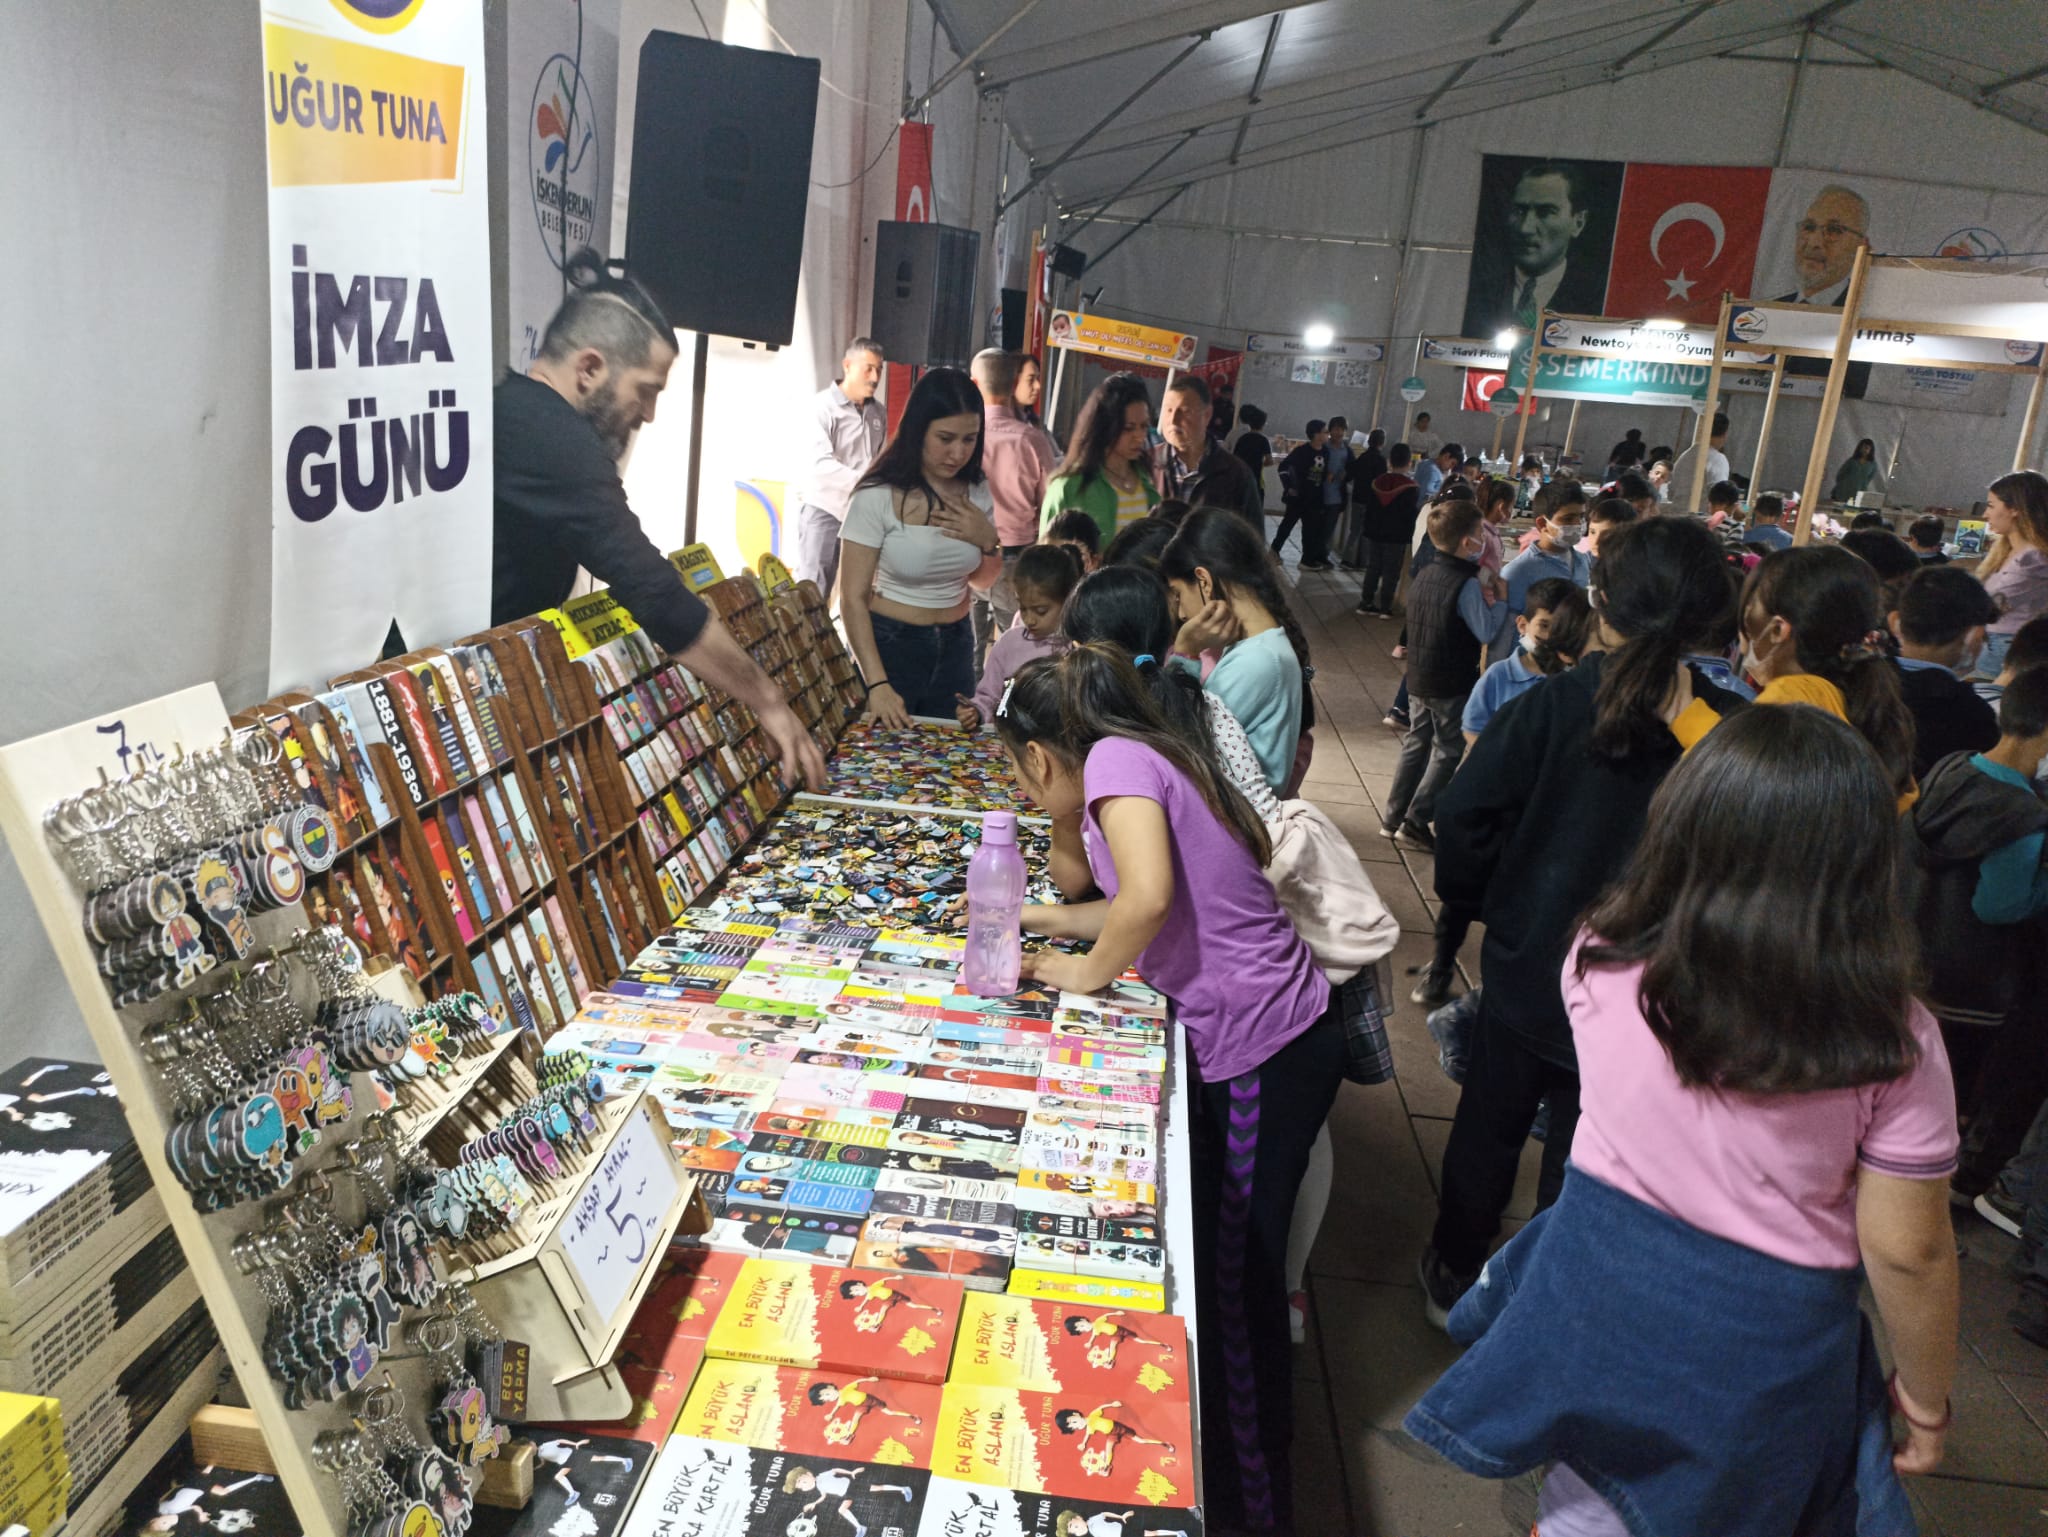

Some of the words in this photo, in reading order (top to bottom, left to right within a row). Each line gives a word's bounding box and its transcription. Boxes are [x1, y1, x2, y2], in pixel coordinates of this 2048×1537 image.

[269, 61, 364, 134] UĞUR
[371, 90, 447, 144] TUNA
[291, 244, 455, 370] İMZA
[286, 389, 470, 523] GÜNÜ
[96, 719, 132, 774] 7
[369, 682, 422, 803] 1881-1938
[605, 1184, 646, 1264] 5
[745, 1276, 773, 1310] BÜYÜK
[738, 1312, 756, 1328] EN
[975, 1311, 997, 1347] BÜYÜK
[513, 1346, 528, 1414] YAPMA
[974, 1348, 990, 1365] EN
[703, 1379, 735, 1421] BÜYÜK
[957, 1407, 981, 1451] BÜYÜK
[663, 1464, 701, 1515] BÜYÜK
[694, 1455, 733, 1516] KARTAL
[754, 1487, 774, 1514] UĞUR
[765, 1456, 785, 1485] TUNA
[955, 1454, 974, 1475] EN
[1036, 1499, 1052, 1528] TUNA
